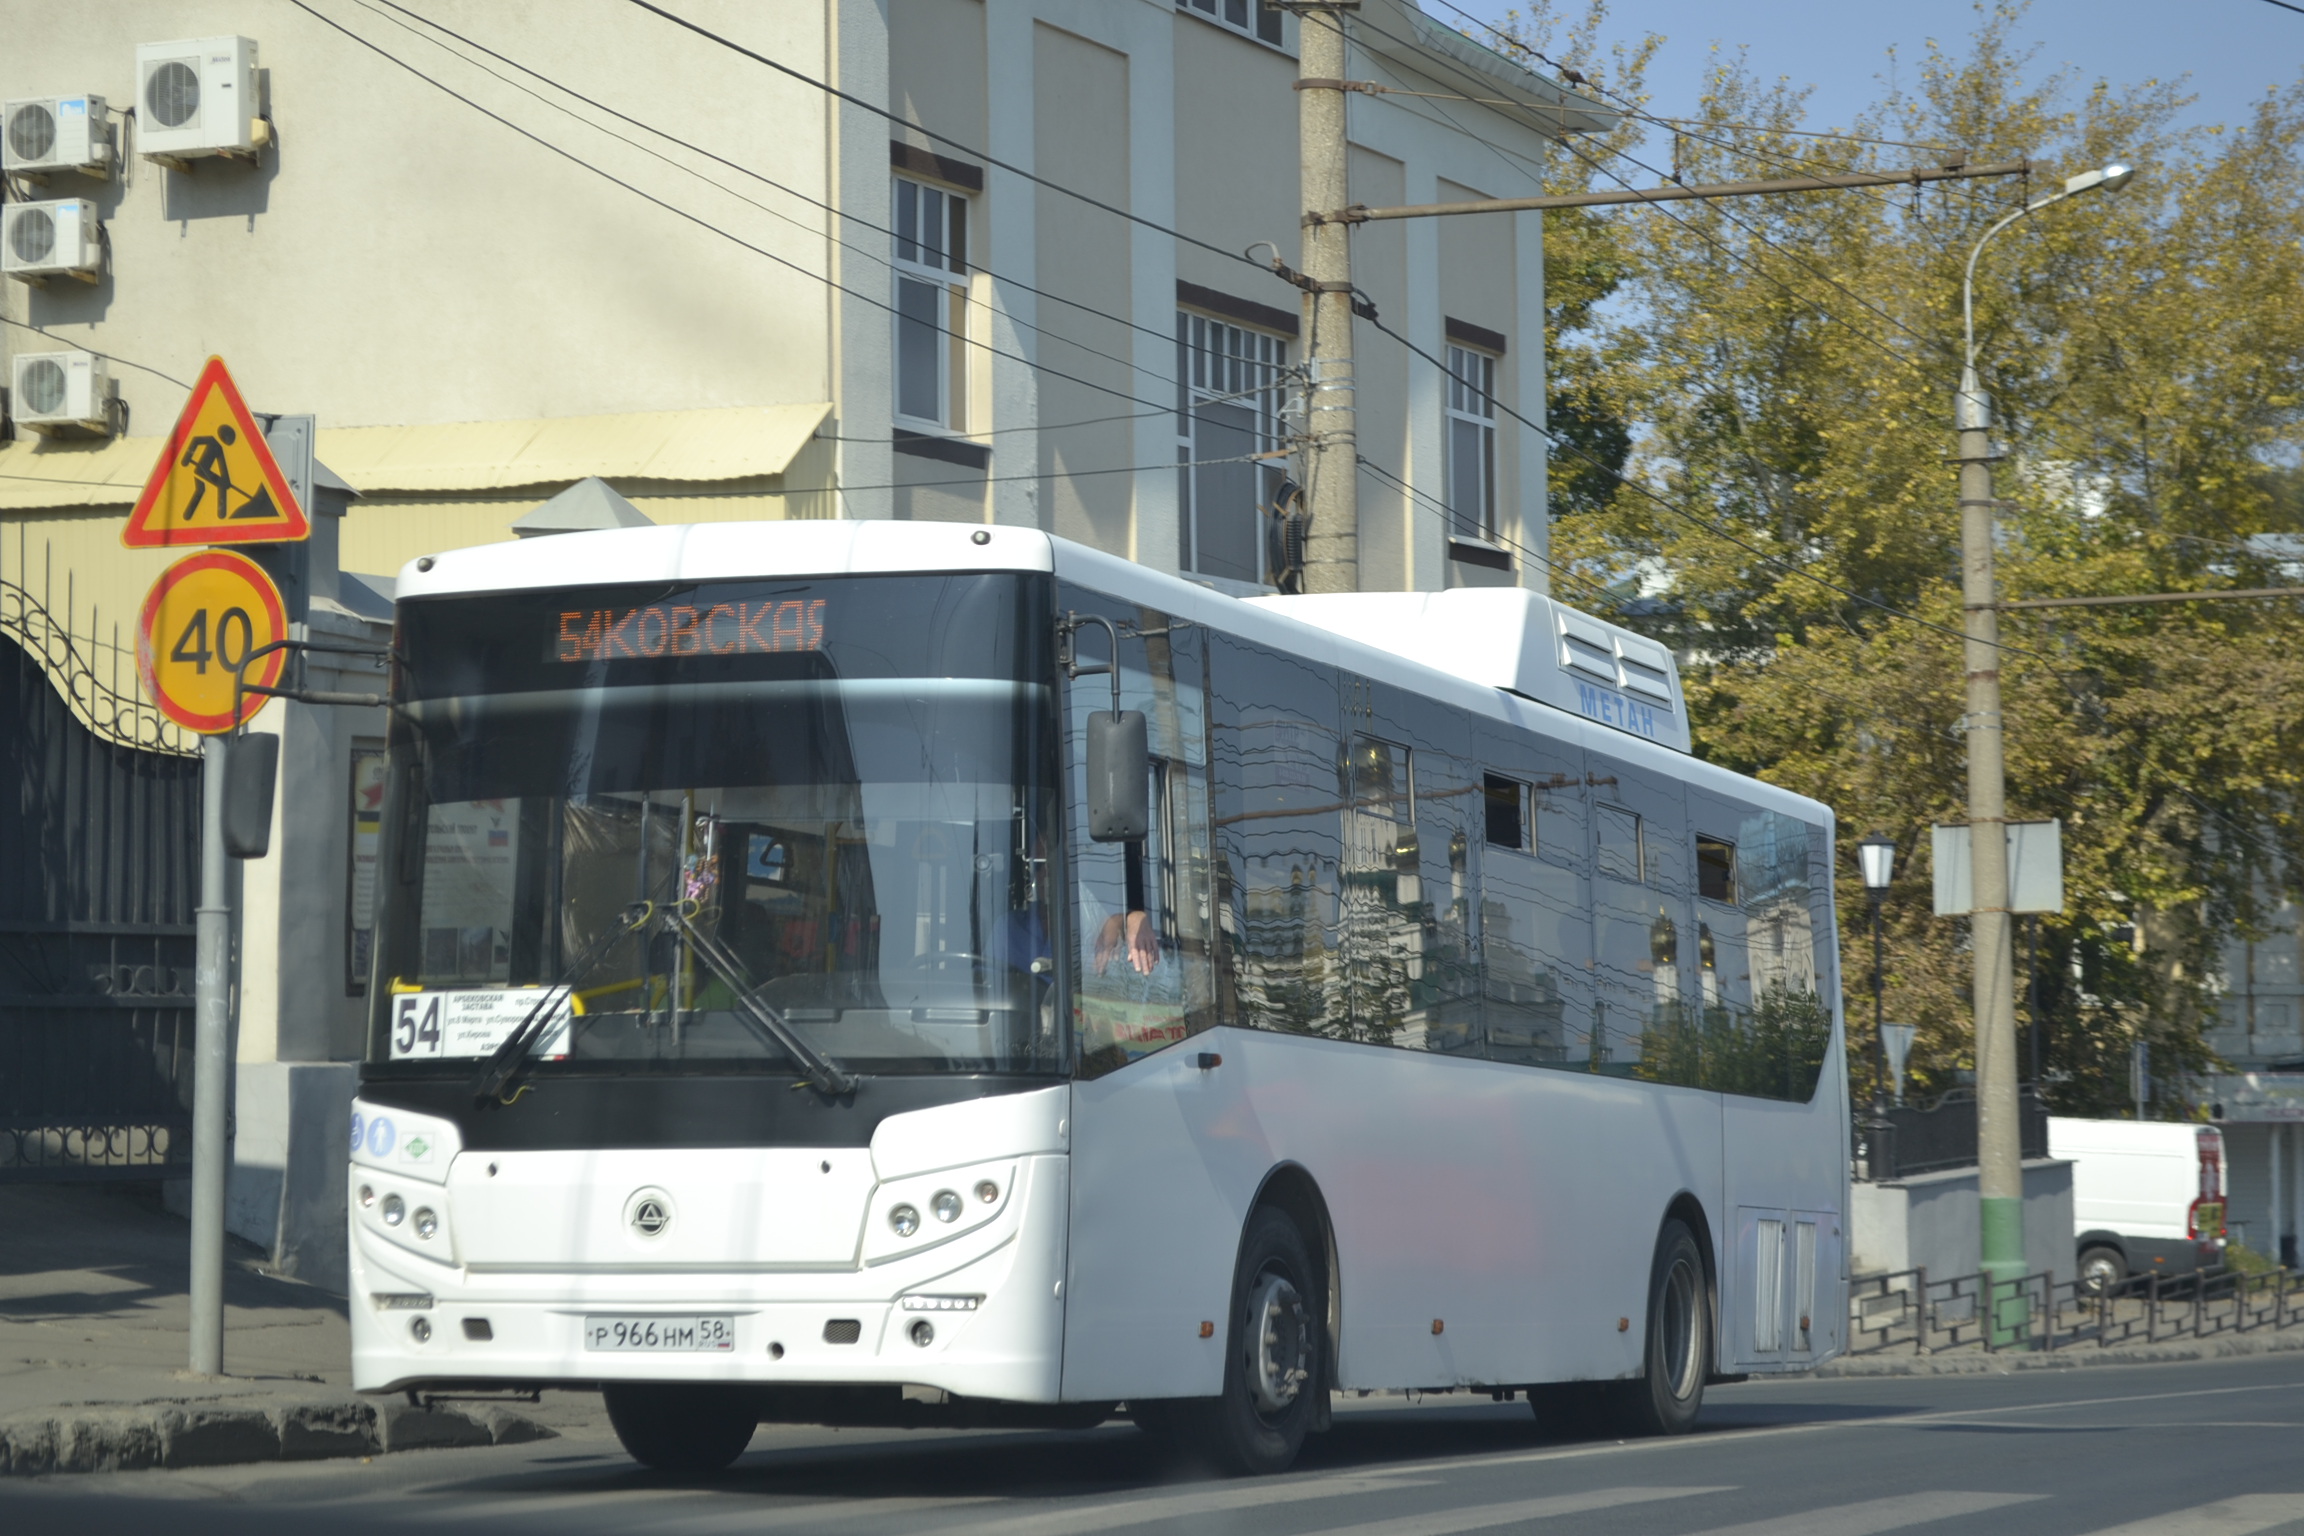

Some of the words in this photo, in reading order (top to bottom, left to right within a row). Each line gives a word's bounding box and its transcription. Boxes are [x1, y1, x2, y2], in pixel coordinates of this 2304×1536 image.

[170, 606, 253, 675] 40
[1580, 684, 1655, 737] МЕТАН
[395, 996, 440, 1054] 54
[701, 1320, 724, 1340] 58
